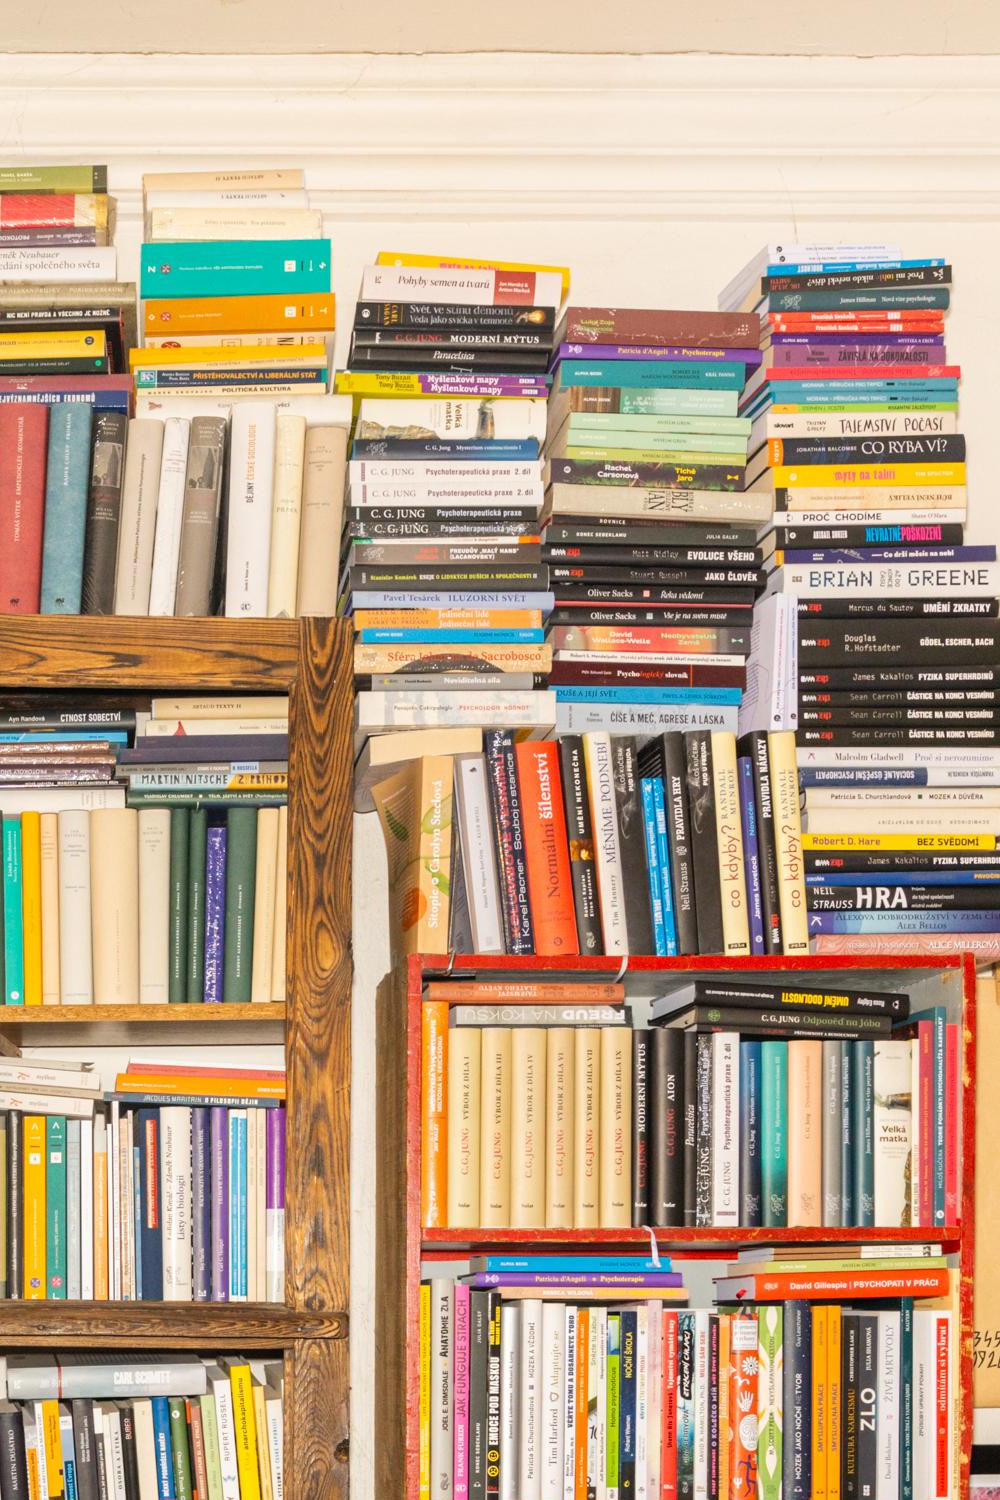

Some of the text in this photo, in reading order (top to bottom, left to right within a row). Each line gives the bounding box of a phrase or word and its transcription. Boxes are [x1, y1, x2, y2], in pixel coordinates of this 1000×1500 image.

[25, 260, 76, 271] společného
[78, 260, 100, 269] světa
[450, 334, 540, 344] MODERNÍ MÝTUS
[840, 417, 943, 434] TAJEMSTVÍ POČASÍ
[861, 438, 947, 454] CO RYBA VÍ?
[803, 512, 881, 521] PROČ CHODÍME
[687, 550, 755, 561] EVOLUCE VŠEHO
[705, 571, 757, 582] JAKO ČLOVĚK
[810, 569, 989, 587] BRIAN GREENE
[923, 602, 991, 613] UMĚNÍ ZKRATKY
[60, 711, 121, 722] CTNOST SOBECTVÍ
[534, 752, 561, 898] Normální šílenství
[812, 837, 845, 845] Robert
[847, 837, 856, 845] D.
[917, 838, 934, 846] BEZ
[937, 837, 979, 846] SVĚDOMÍ
[721, 825, 742, 908] co kdyby?
[813, 887, 834, 895] NEIL
[813, 887, 908, 909] STRAUSS HRA
[781, 992, 849, 1008] UMĚNÍ ODOLNOSTI
[666, 1074, 675, 1101] AION
[880, 1135, 908, 1143] matka
[790, 1282, 812, 1290] David
[853, 1280, 904, 1288] PSYCHOPATI
[913, 1278, 938, 1286] PRÁCI
[489, 1357, 499, 1445] EMOCE POD MASKOU
[860, 1388, 876, 1431] ZLO
